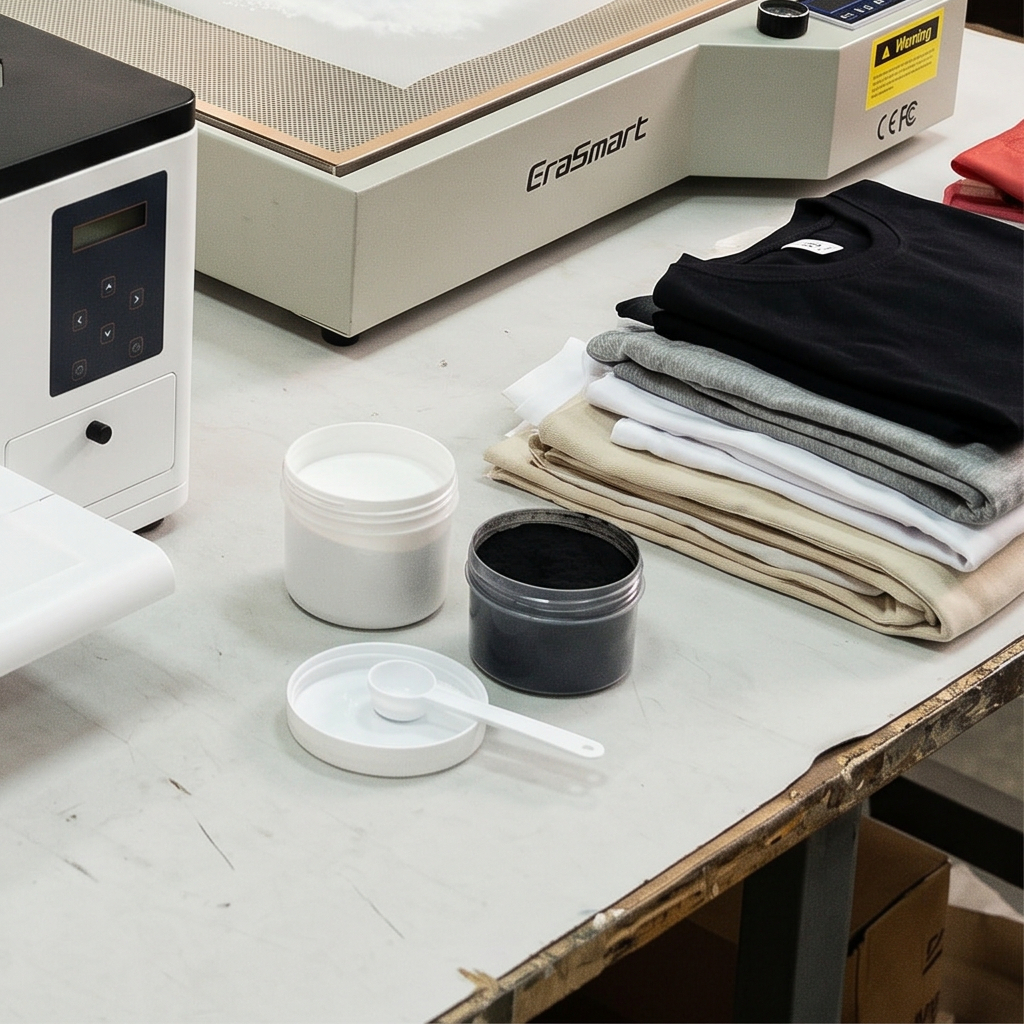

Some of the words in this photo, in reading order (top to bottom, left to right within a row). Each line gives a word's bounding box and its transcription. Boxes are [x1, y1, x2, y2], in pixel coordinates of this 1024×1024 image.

[895, 26, 932, 53] Warning
[877, 108, 898, 140] CE
[526, 116, 649, 192] EraSmart
